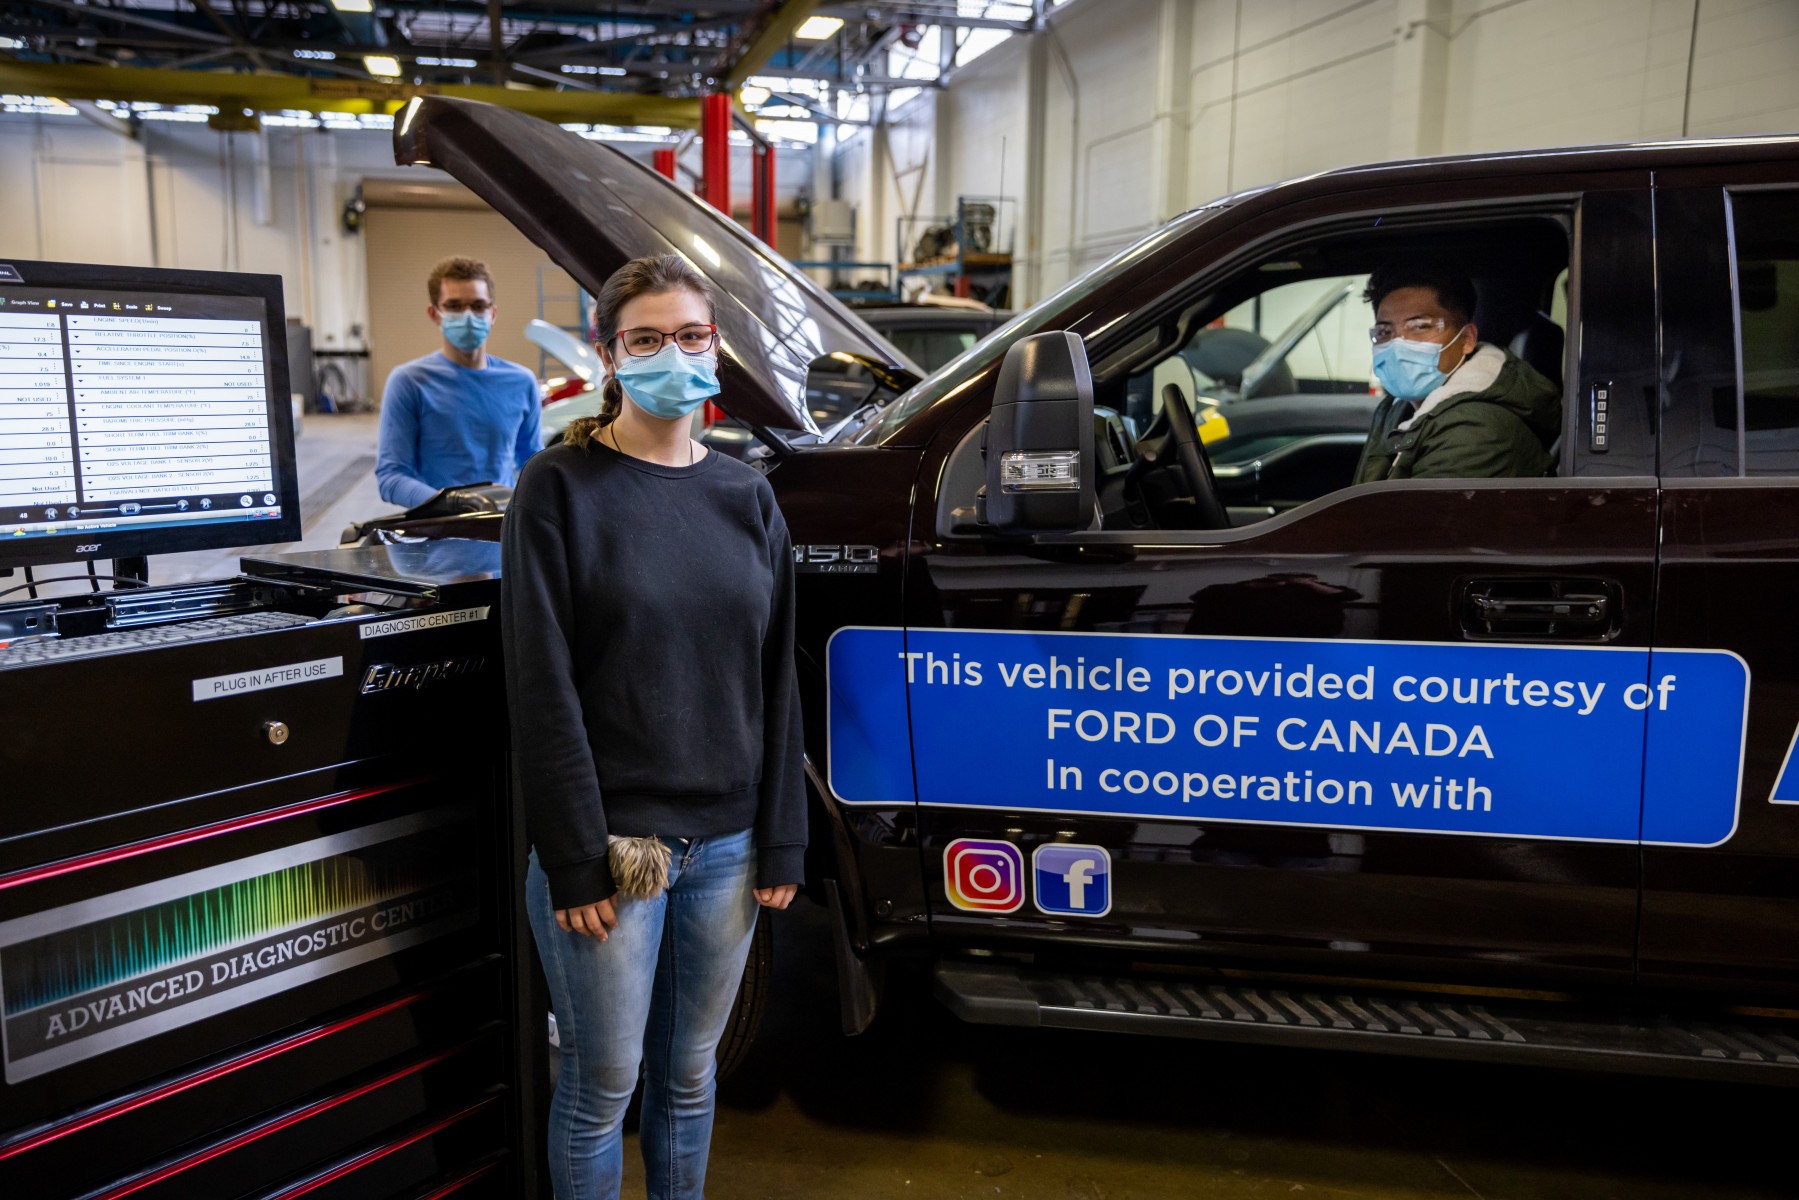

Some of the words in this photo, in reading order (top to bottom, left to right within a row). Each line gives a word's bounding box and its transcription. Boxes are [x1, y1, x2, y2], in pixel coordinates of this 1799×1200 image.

[75, 543, 102, 553] acer
[365, 618, 426, 637] DIAGNOSTIC
[428, 611, 466, 626] CENTER
[468, 610, 479, 619] #1
[214, 678, 247, 693] PLUG
[250, 674, 261, 687] IN
[264, 668, 301, 684] AFTER
[304, 663, 327, 677] USE
[898, 652, 983, 686] This
[998, 656, 1151, 692] vehicle
[1168, 658, 1375, 700] provided
[1392, 672, 1606, 716] courtesy
[1623, 675, 1677, 711] of
[1048, 708, 1176, 745] FORD
[1193, 713, 1260, 747] OF
[1276, 718, 1494, 759] CANADA
[1046, 759, 1082, 790] In
[1099, 767, 1372, 805] cooperation
[1391, 776, 1493, 812] with
[45, 970, 204, 1040] ADVANCED
[210, 917, 366, 986] DIAGNOSTIC
